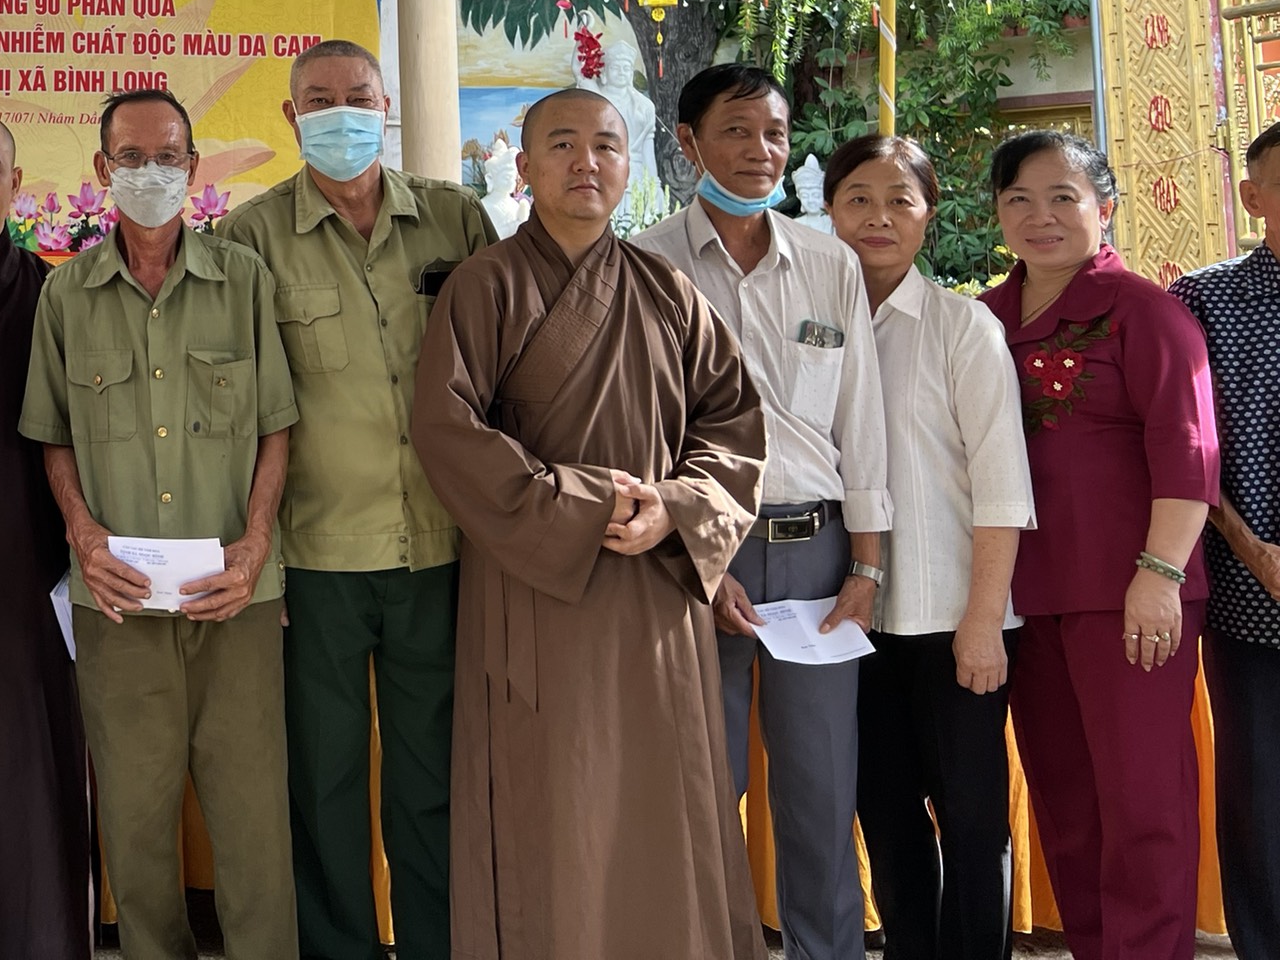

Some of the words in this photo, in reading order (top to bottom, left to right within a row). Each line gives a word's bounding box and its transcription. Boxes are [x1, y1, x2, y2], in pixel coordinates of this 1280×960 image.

[72, 25, 126, 55] CHẤT
[133, 28, 176, 60] ĐỘC
[183, 30, 231, 56] MÀU
[238, 34, 267, 57] DA
[18, 66, 46, 91] XÃ
[54, 65, 105, 92] BÌNH
[112, 71, 167, 93] LONG
[38, 112, 75, 124] Nhâm
